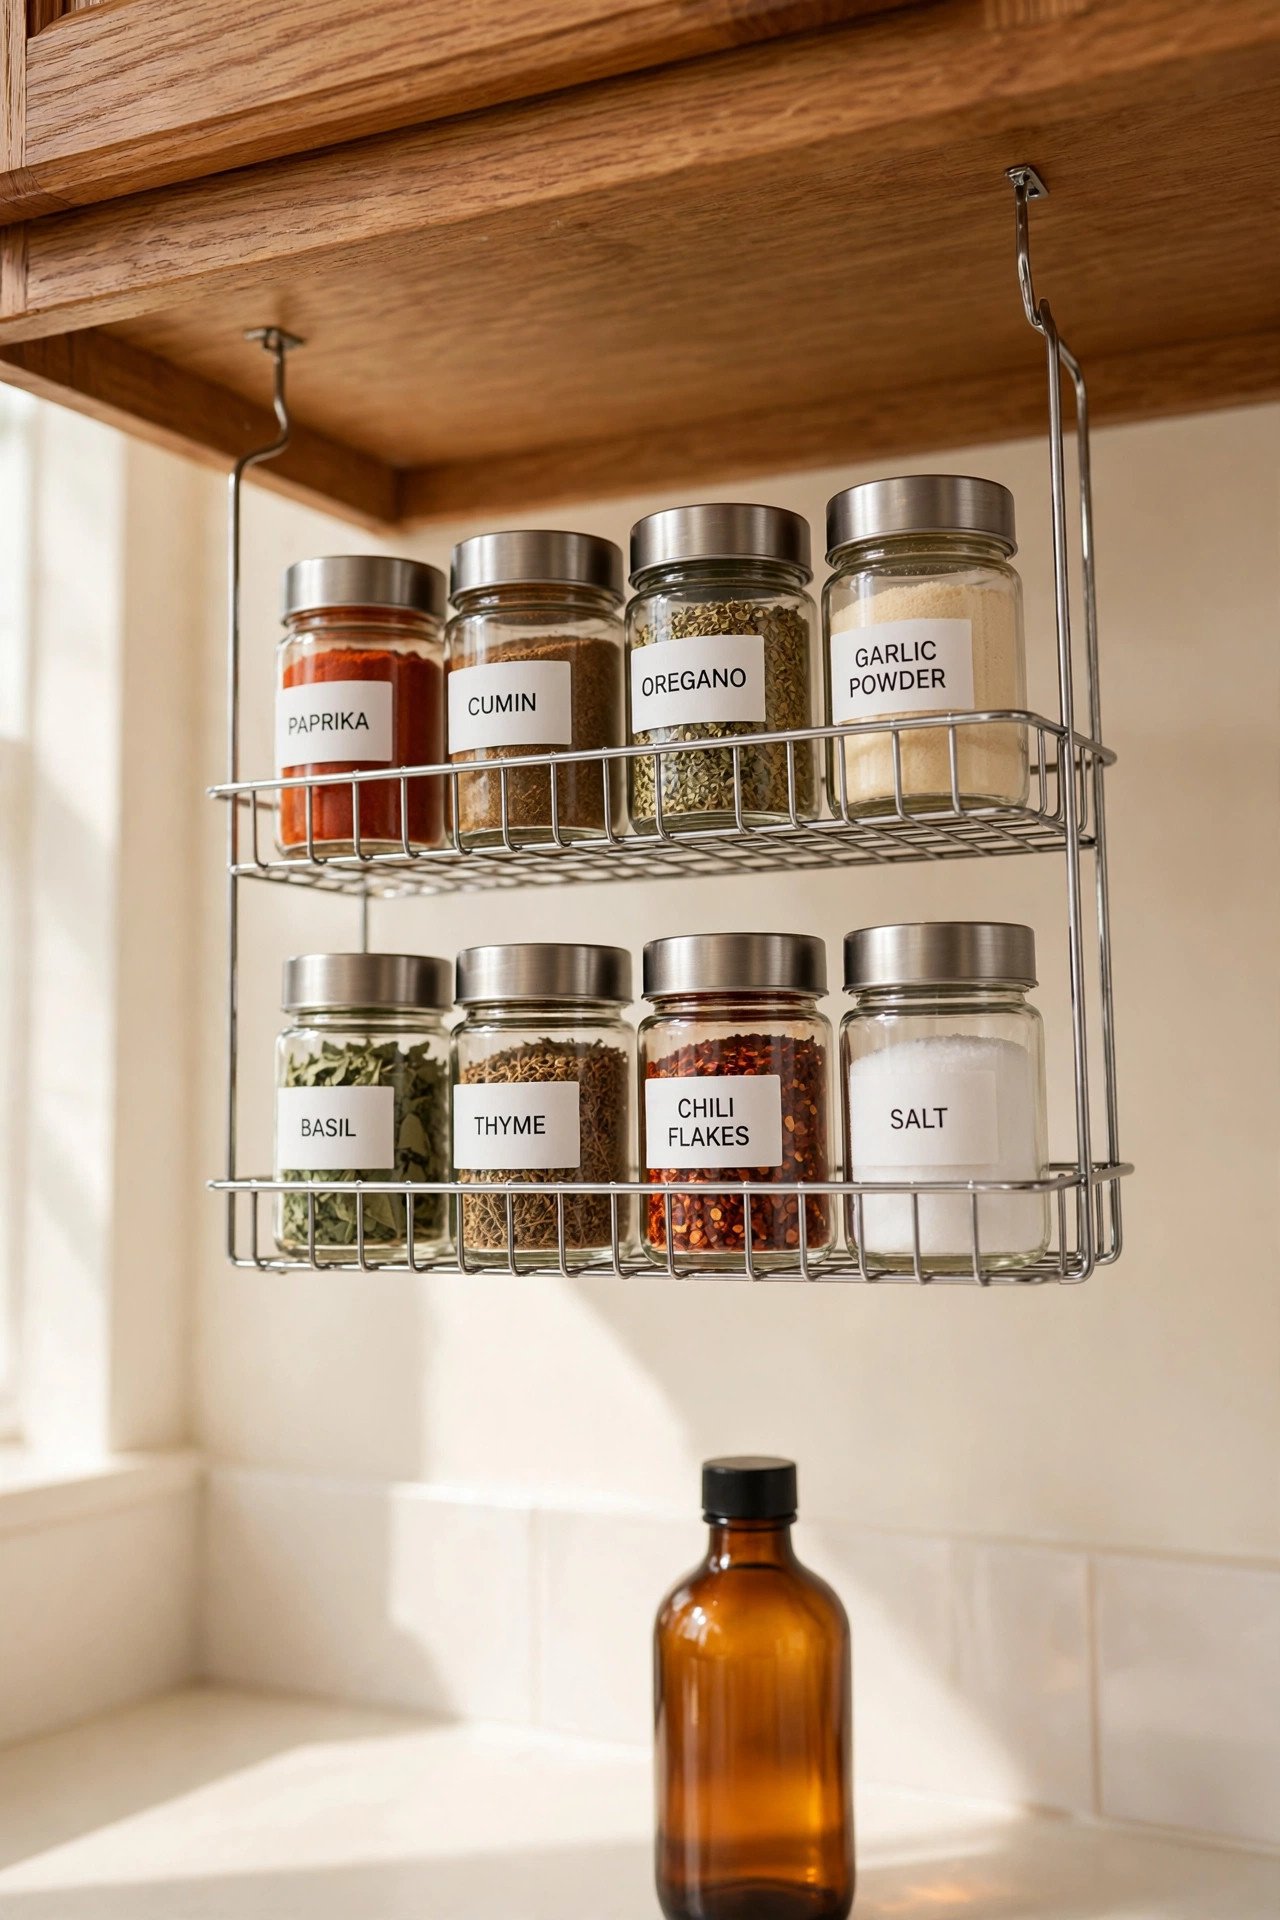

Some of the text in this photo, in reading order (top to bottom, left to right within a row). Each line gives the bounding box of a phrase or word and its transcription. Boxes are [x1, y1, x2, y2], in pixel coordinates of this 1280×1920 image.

[855, 640, 937, 668] GARLIC
[641, 667, 747, 697] OREGANO
[848, 667, 947, 698] POWDER
[467, 692, 537, 716] CUMIN
[288, 711, 369, 735] PAPRIKA
[677, 1097, 734, 1119] CHILI
[890, 1107, 949, 1130] SALT
[300, 1118, 357, 1138] BASIL
[473, 1115, 546, 1136] THYME
[667, 1125, 750, 1147] FLAKES
